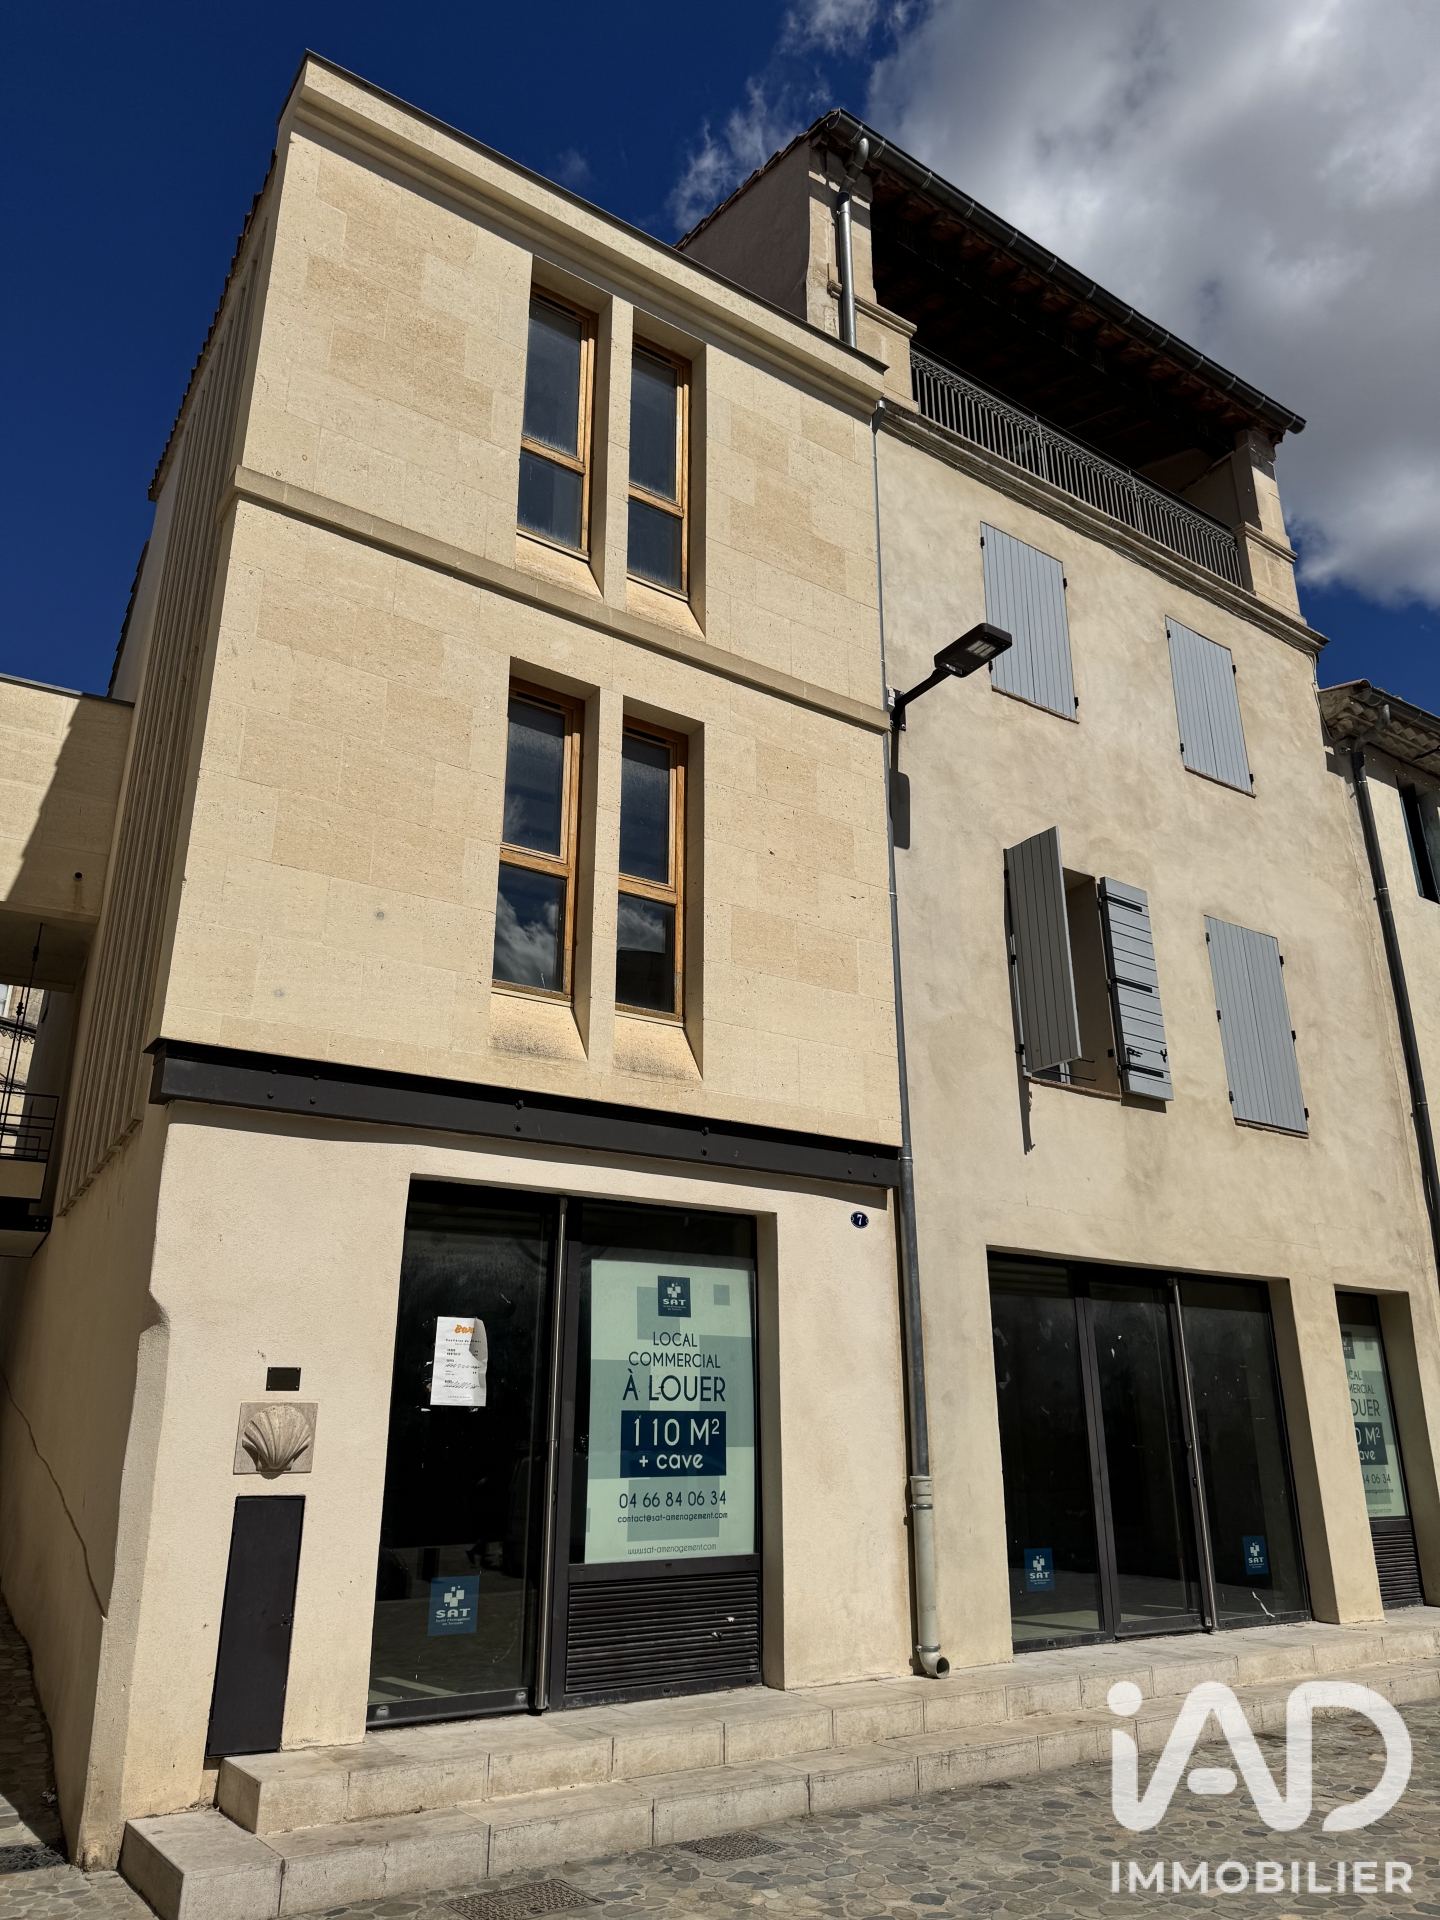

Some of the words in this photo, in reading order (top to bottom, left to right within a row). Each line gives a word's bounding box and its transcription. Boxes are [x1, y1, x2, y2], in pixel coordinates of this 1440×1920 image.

[856, 1213, 863, 1226] 7
[662, 1298, 687, 1306] SAT
[652, 1331, 698, 1347] LOCAL
[628, 1351, 721, 1369] COMMERCIAL
[1347, 1369, 1362, 1380] CAL
[622, 1368, 639, 1401] À
[648, 1374, 726, 1402] LOUER
[1349, 1383, 1375, 1394] MERCIAL
[1350, 1398, 1381, 1417] OUER
[633, 1418, 680, 1447] 110
[656, 1453, 704, 1470] cave
[1359, 1450, 1376, 1461] ave
[1371, 1473, 1381, 1484] 06
[1382, 1473, 1392, 1484] 34
[619, 1493, 637, 1509] 04
[642, 1491, 661, 1508] 66
[665, 1491, 683, 1507] 84
[687, 1490, 706, 1507] 06
[710, 1489, 727, 1506] 34
[617, 1512, 729, 1523] contact@sat-amenagement.com
[1029, 1571, 1050, 1579] SAT
[436, 1608, 471, 1618] SAT
